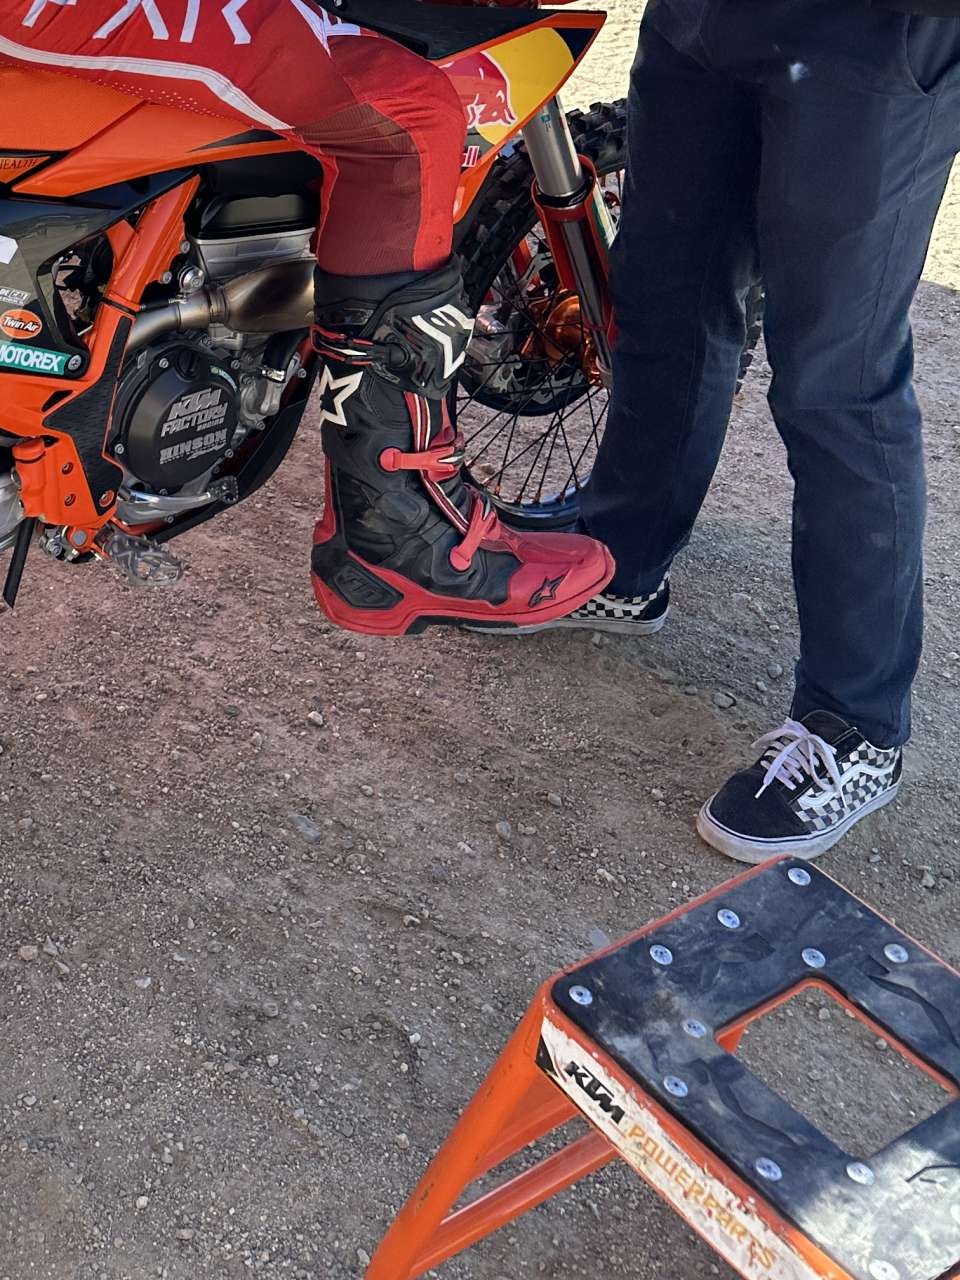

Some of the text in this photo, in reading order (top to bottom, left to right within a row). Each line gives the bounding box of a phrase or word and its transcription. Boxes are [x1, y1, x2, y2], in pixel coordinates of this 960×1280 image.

[3, 317, 39, 332] Twin Air
[161, 402, 228, 437] FACTORY
[167, 388, 222, 422] KTM
[160, 428, 228, 462] HINSON
[563, 1060, 779, 1271] KTM POWERPARTS
